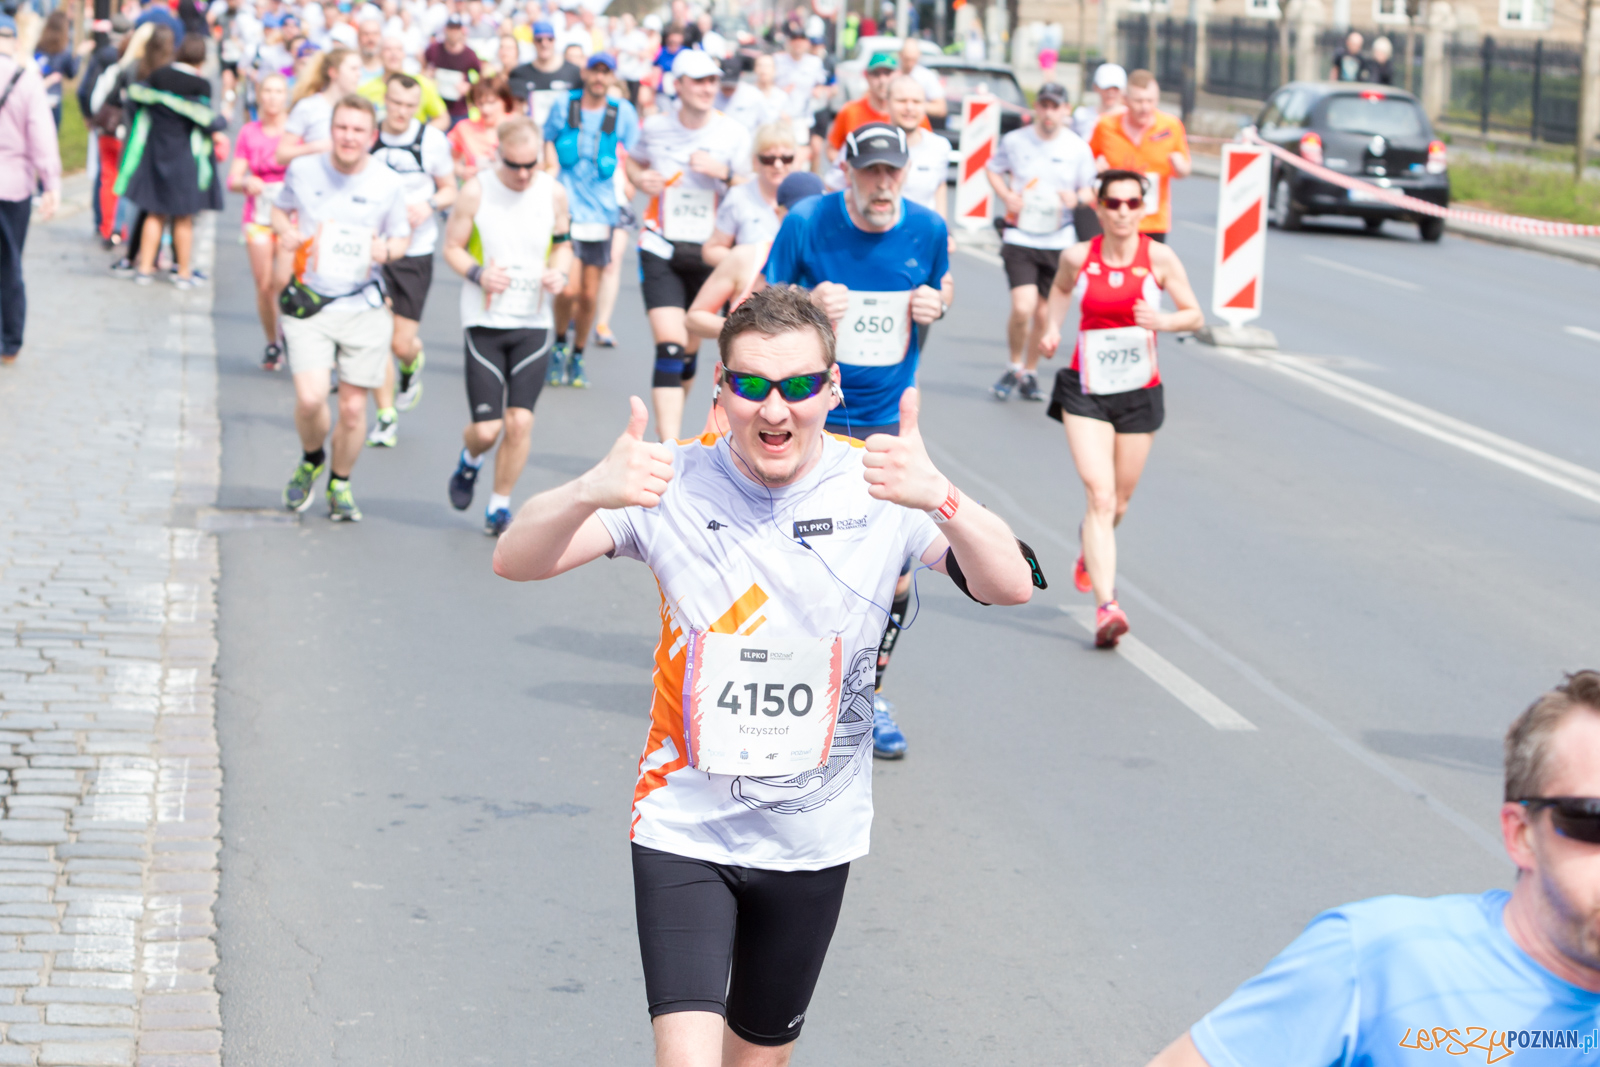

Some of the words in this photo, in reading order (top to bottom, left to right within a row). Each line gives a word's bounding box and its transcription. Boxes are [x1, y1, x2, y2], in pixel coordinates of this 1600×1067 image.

[332, 242, 362, 257] 602
[853, 316, 894, 333] 650
[1096, 347, 1141, 366] 9975
[716, 680, 814, 718] 4150
[738, 724, 790, 736] Krzysztof
